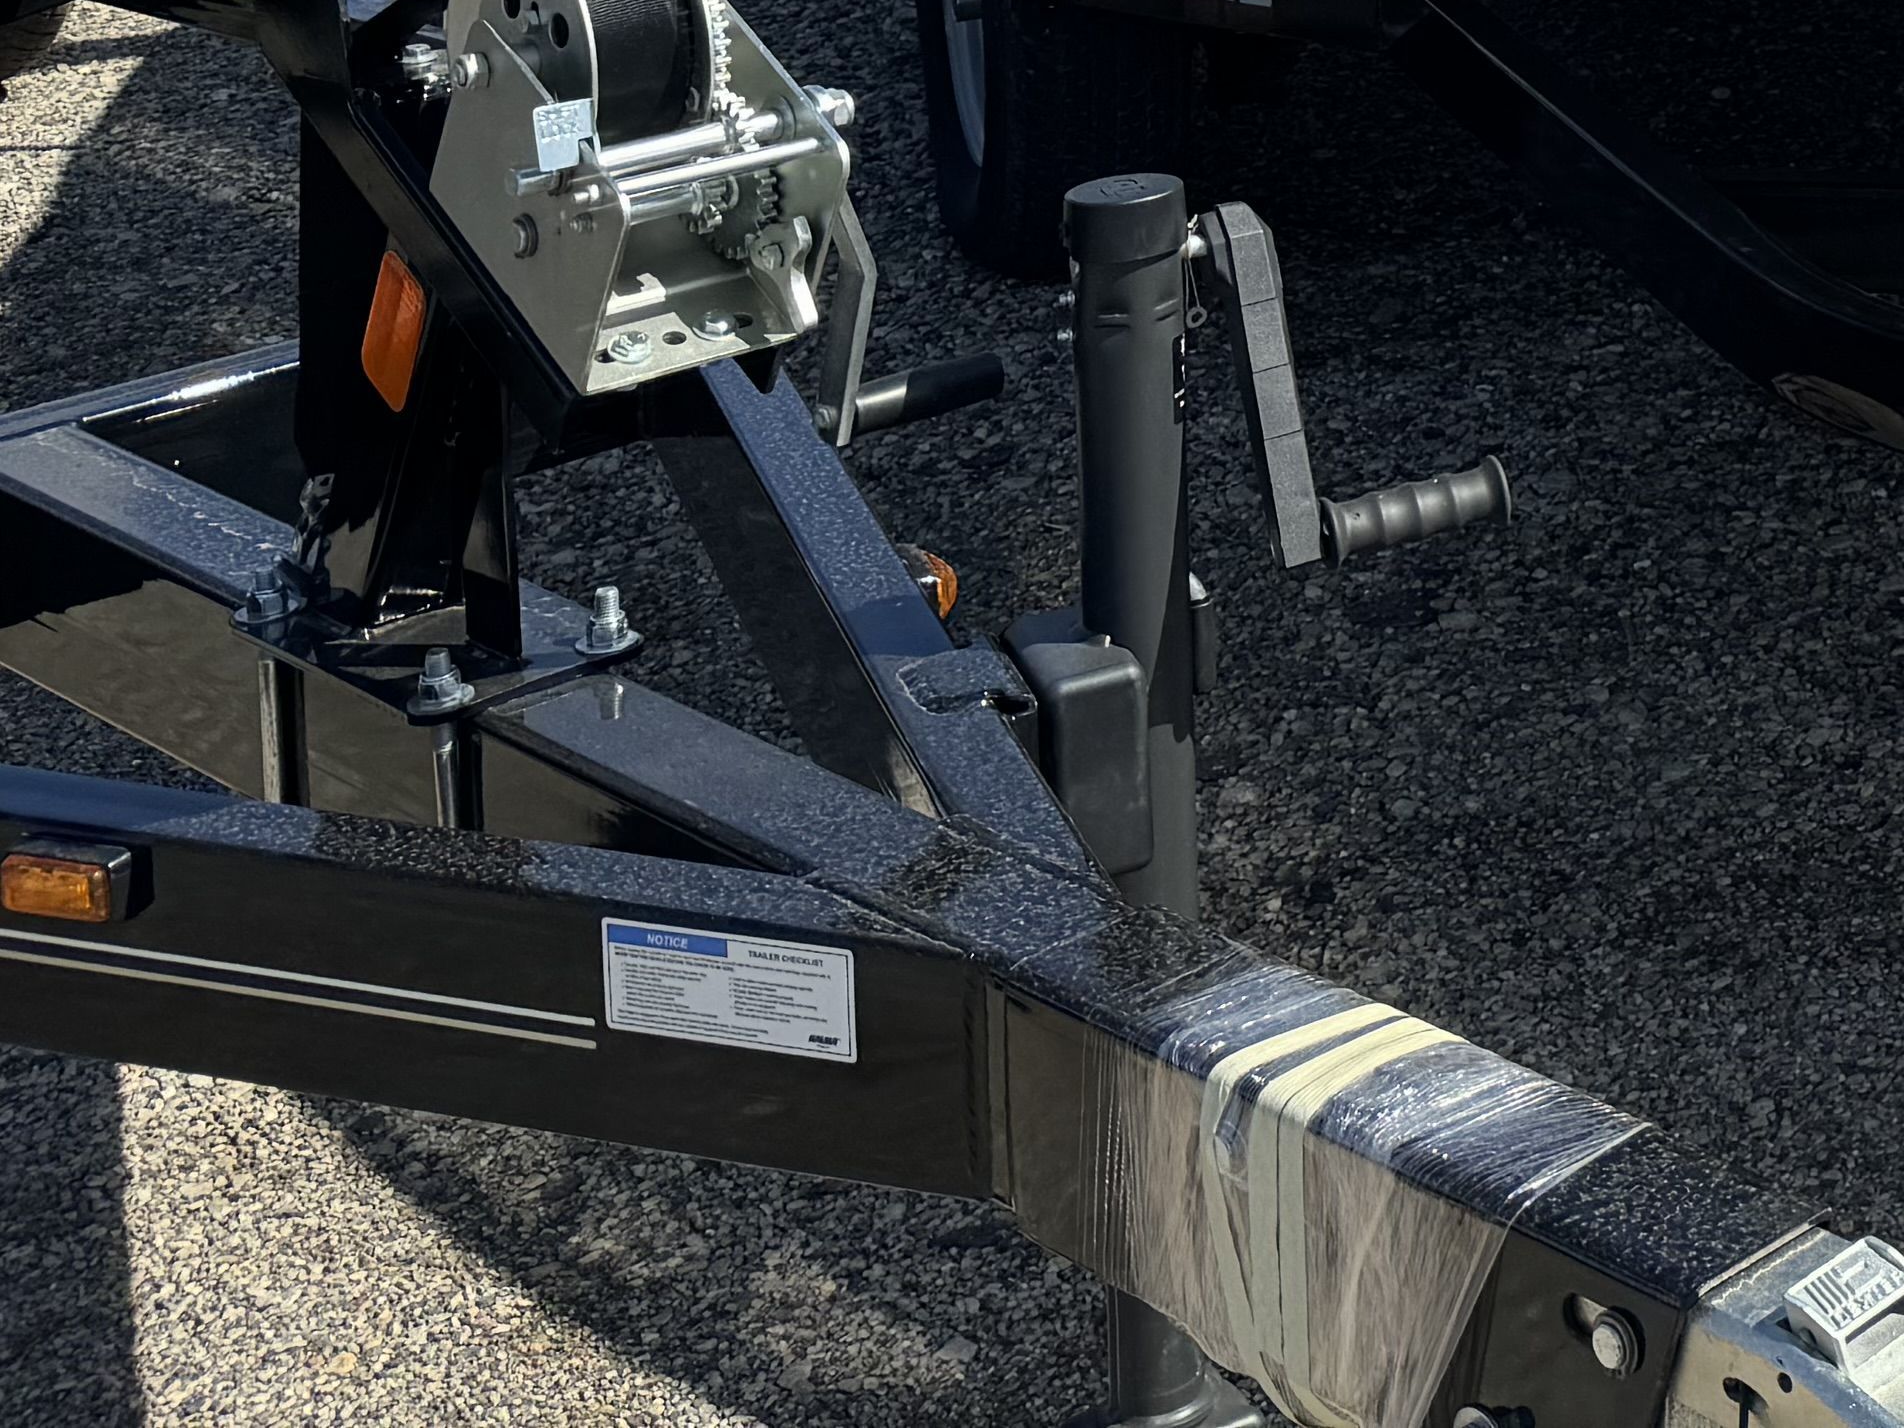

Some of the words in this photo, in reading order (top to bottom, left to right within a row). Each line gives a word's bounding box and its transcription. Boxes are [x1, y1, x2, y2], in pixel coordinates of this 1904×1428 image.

[646, 933, 689, 950] NOTICE
[748, 949, 781, 963] TRAILER
[781, 953, 825, 968] CHECKLIST
